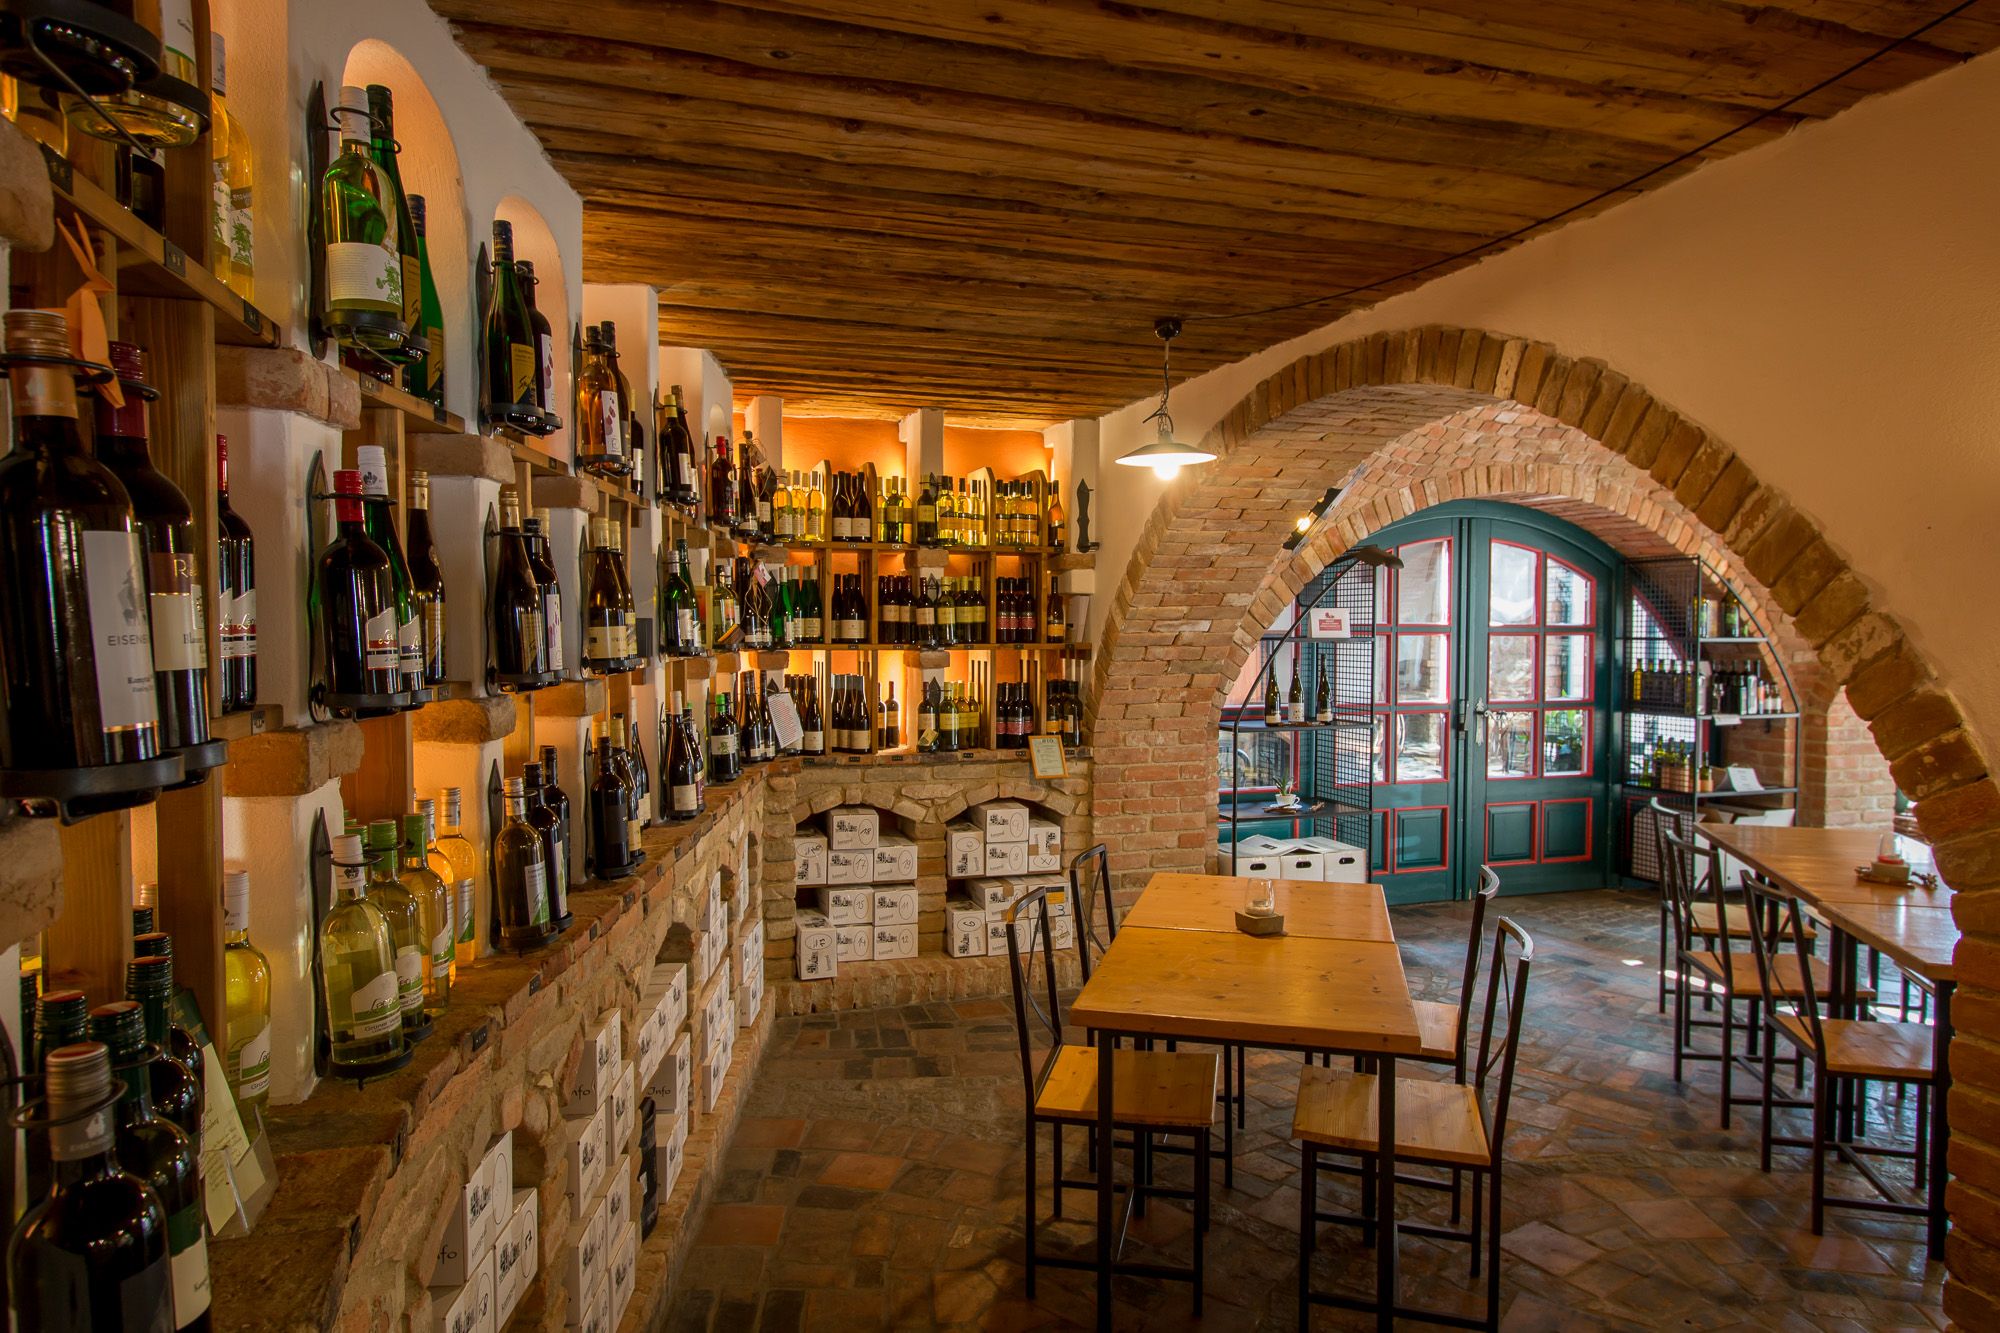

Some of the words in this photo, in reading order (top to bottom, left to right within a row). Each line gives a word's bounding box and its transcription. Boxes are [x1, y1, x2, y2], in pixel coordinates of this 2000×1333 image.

[1056, 904, 1066, 916] 3
[571, 1086, 591, 1100] nfo
[648, 1086, 671, 1096] Info
